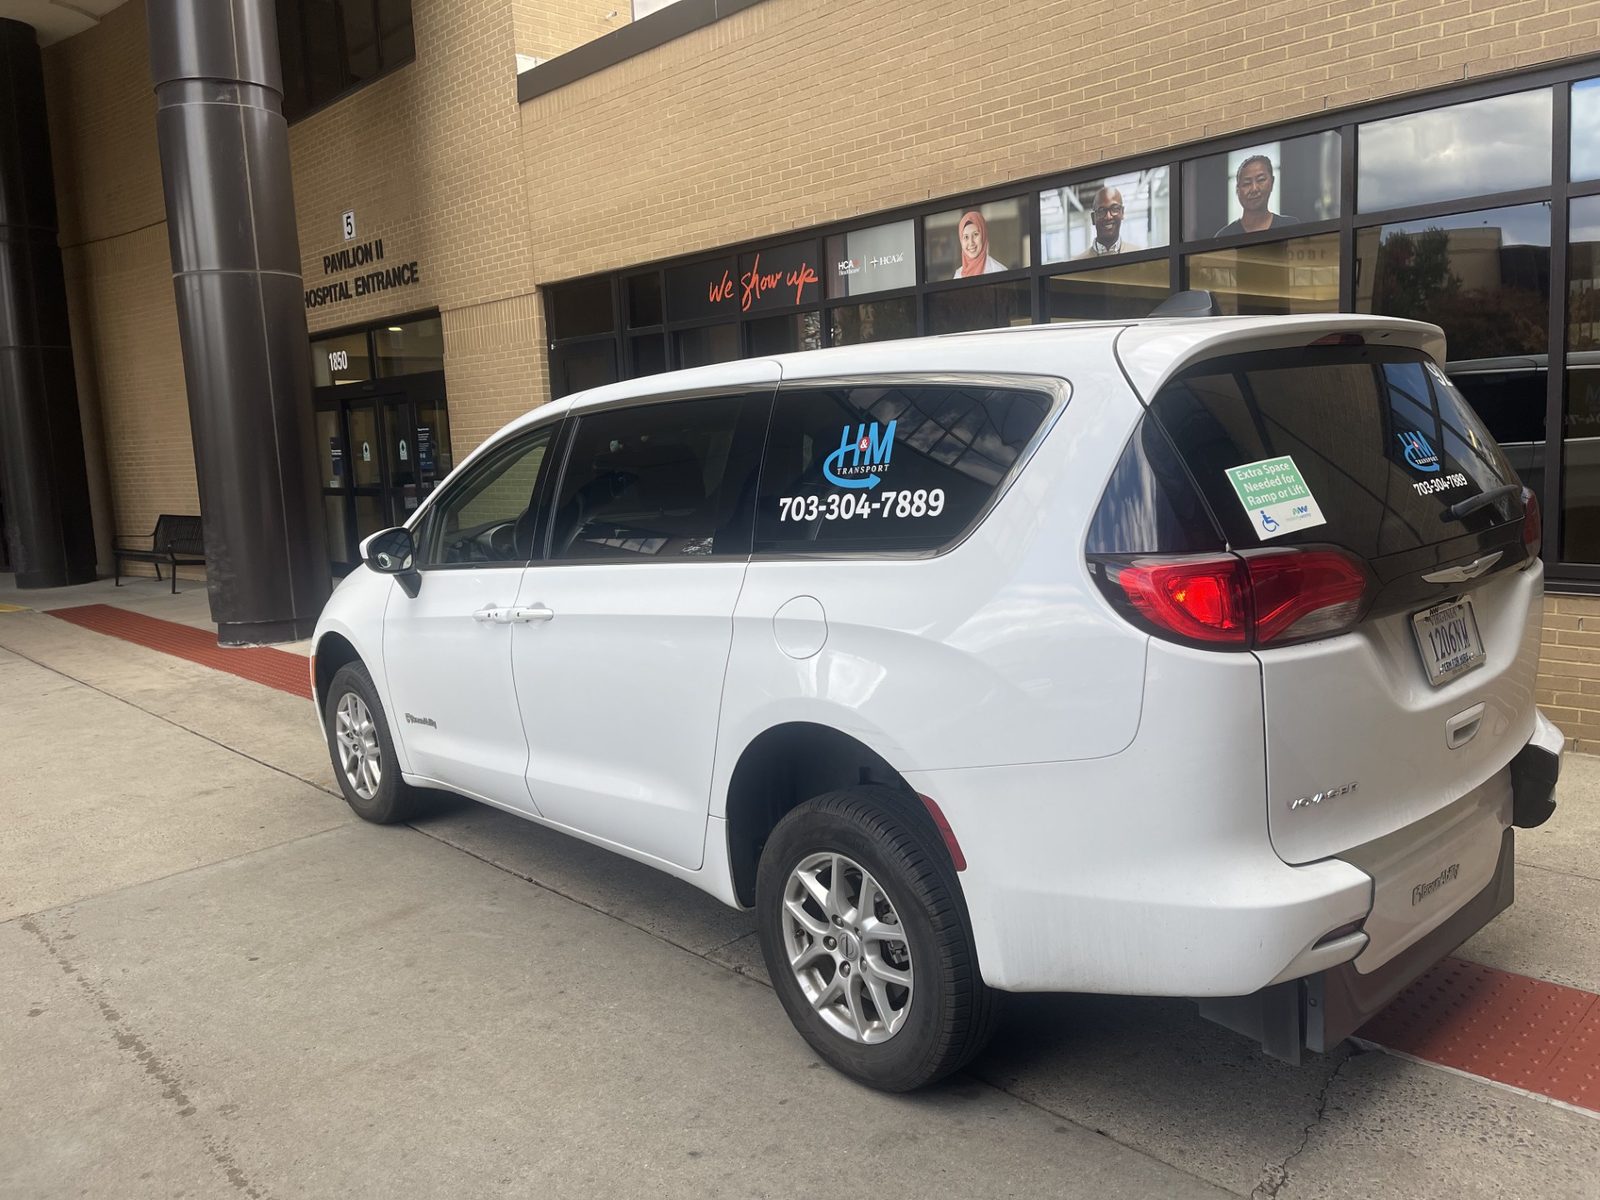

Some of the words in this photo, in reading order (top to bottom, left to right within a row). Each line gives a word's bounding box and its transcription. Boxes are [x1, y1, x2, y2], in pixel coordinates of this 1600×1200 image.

[345, 215, 354, 236] 5
[323, 242, 374, 275] PAVILION
[374, 238, 384, 260] II
[838, 260, 854, 270] HCA
[354, 261, 420, 297] ENTRANCE
[740, 253, 782, 312] show
[786, 262, 819, 305] up
[328, 350, 348, 371] 1850
[836, 463, 890, 475] TRANSPORT
[1235, 466, 1264, 481] Extra
[1262, 461, 1290, 476] Space
[1242, 477, 1282, 494] Needed
[1280, 473, 1296, 486] for
[1412, 472, 1468, 497] 703-304-7889
[779, 488, 946, 522] 703-304-7889
[1246, 493, 1278, 507] Ramp
[1277, 489, 1290, 499] or
[1287, 483, 1306, 496] Lift
